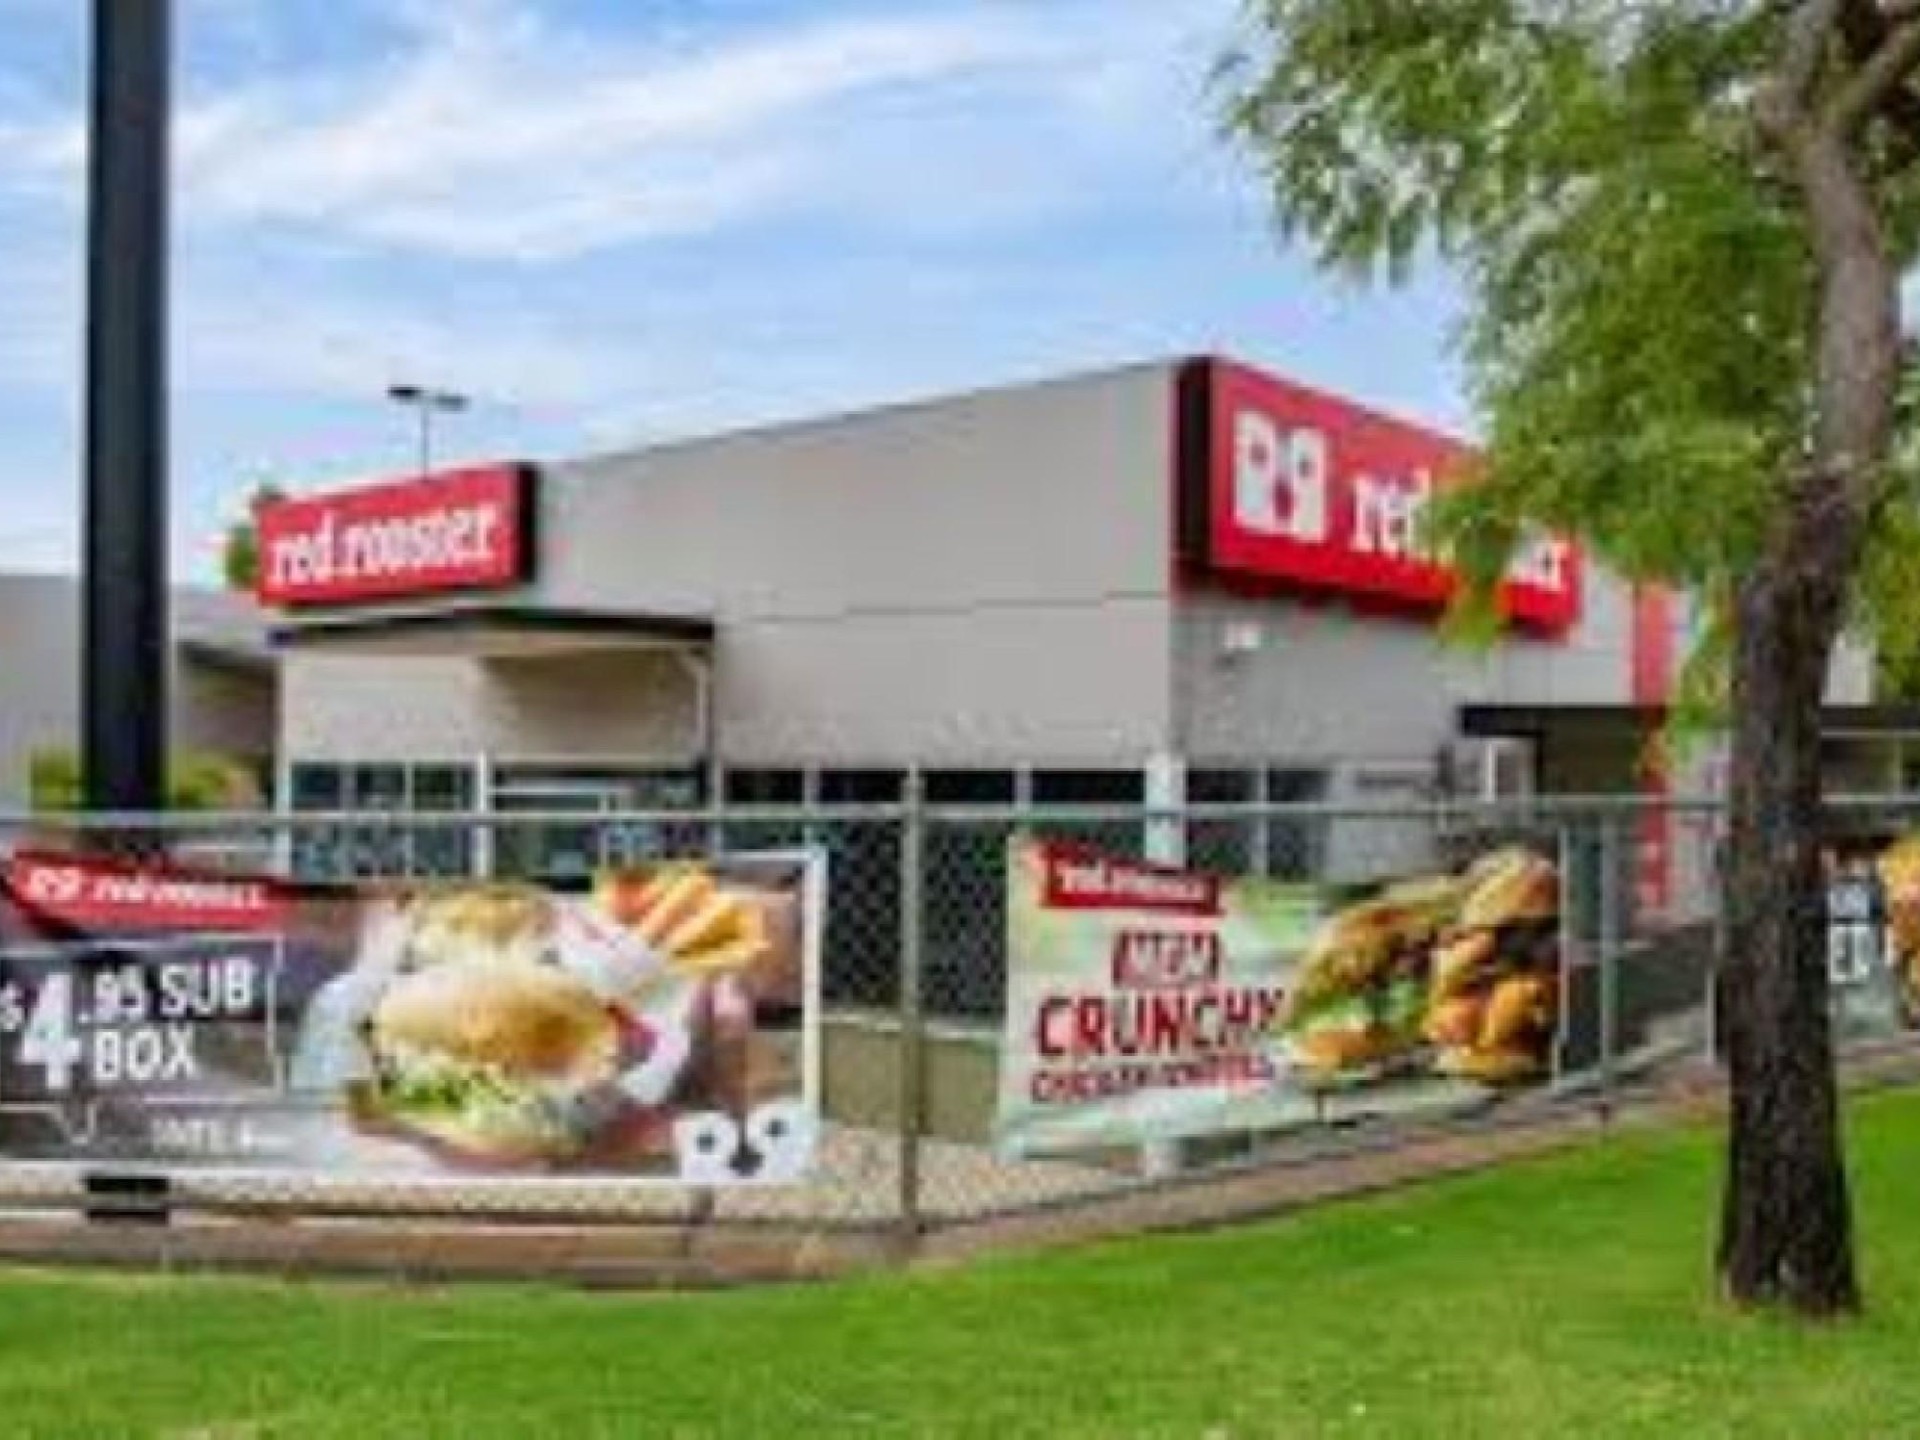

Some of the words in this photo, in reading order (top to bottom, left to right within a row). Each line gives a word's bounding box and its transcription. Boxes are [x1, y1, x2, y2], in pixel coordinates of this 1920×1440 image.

[160, 958, 254, 1016] SUB
[1037, 986, 1286, 1056] CRUNCHY
[94, 1028, 197, 1081] BOX
